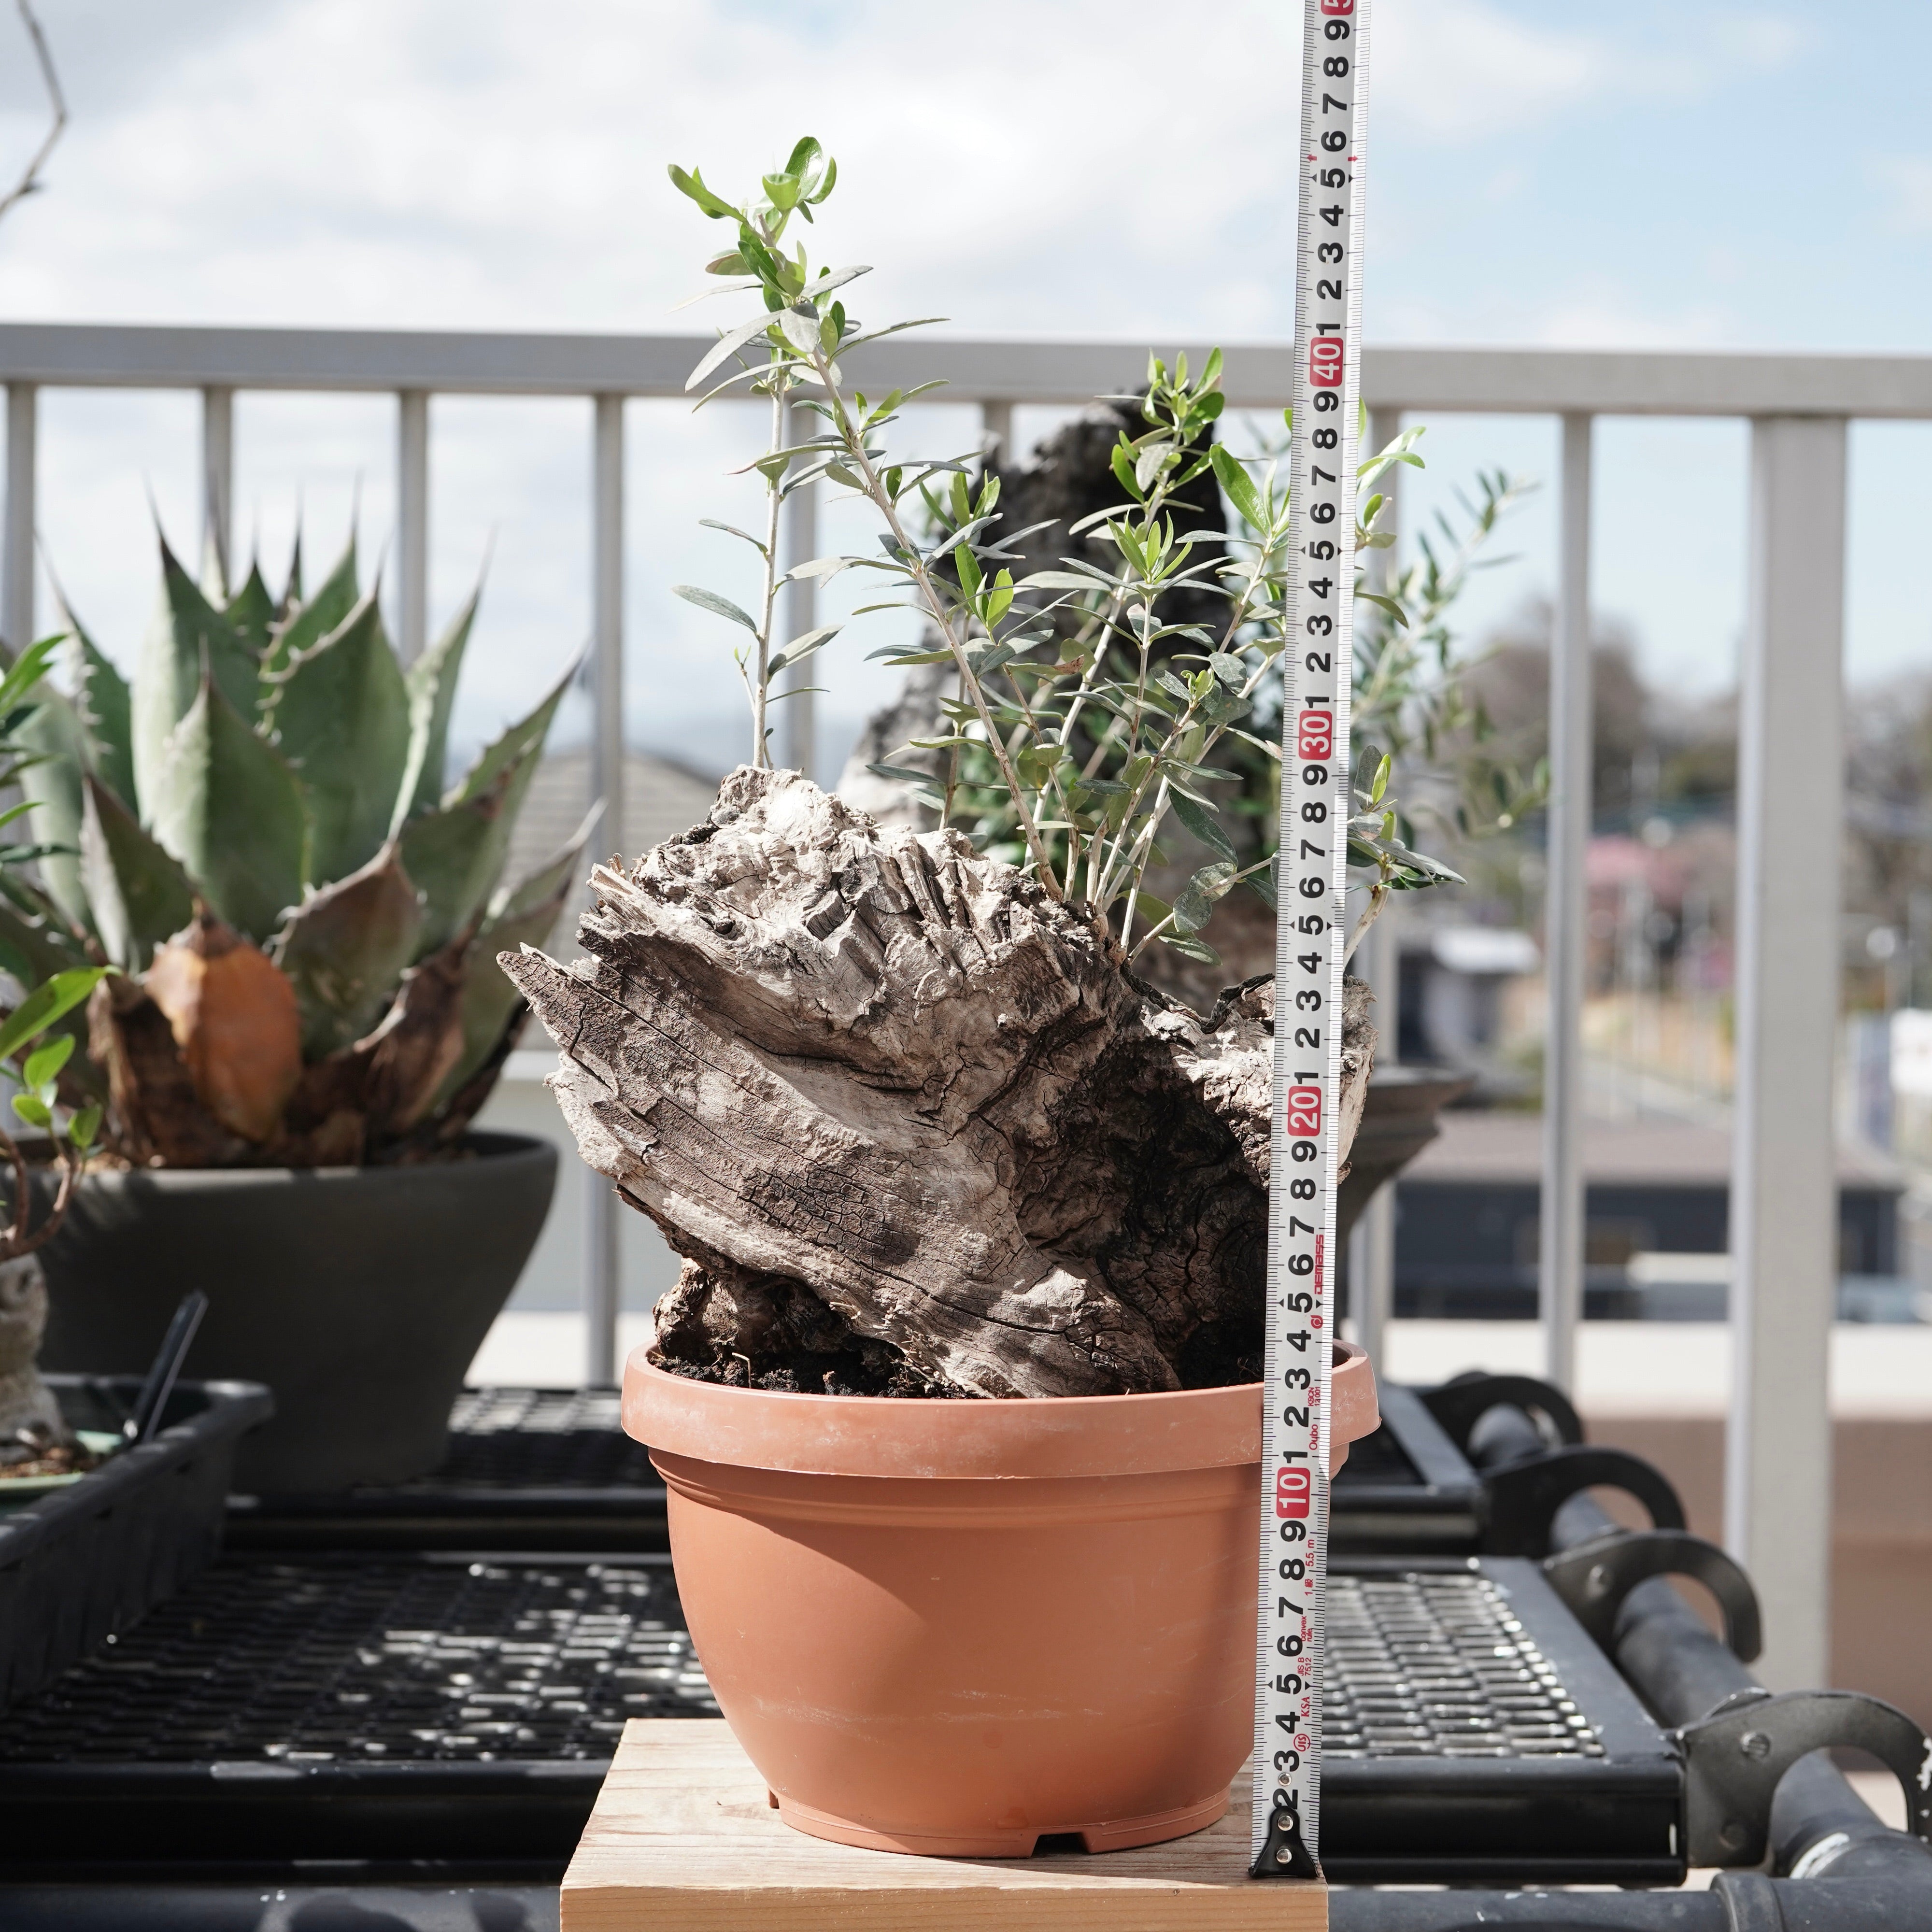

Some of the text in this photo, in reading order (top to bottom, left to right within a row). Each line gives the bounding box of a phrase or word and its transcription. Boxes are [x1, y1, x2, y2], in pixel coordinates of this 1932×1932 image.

[1325, 20, 1350, 40] 9
[1323, 57, 1349, 77] 8
[1322, 94, 1347, 114] 7
[1321, 131, 1346, 152] 6
[1321, 168, 1345, 188] 5
[1320, 205, 1344, 226] 4
[1318, 242, 1343, 263] 3
[1317, 280, 1341, 299] 2
[1316, 324, 1340, 336] 1
[1313, 343, 1340, 379] 40
[1314, 391, 1338, 412] 9
[1312, 428, 1337, 449] 8
[1311, 466, 1336, 485] 7
[1310, 503, 1335, 524] 6
[1309, 540, 1334, 560] 5
[1308, 577, 1333, 598] 4
[1307, 615, 1332, 636] 3
[1306, 652, 1331, 672] 2
[1305, 696, 1329, 708] 1
[1302, 716, 1330, 753] 30
[1303, 765, 1327, 785] 9
[1302, 802, 1326, 823] 8
[1301, 839, 1325, 859] 7
[1299, 877, 1324, 898] 6
[1299, 915, 1323, 935] 5
[1298, 952, 1322, 974] 4
[1296, 990, 1321, 1011] 3
[1295, 1028, 1320, 1048] 2
[1294, 1072, 1318, 1084] 1
[1290, 1092, 1319, 1130] 20
[1292, 1141, 1317, 1162] 9
[1291, 1179, 1316, 1200] 8
[1290, 1216, 1314, 1236] 7
[1288, 1254, 1313, 1275] 6
[1288, 1293, 1312, 1313] 5
[1287, 1330, 1311, 1351] 4
[1285, 1368, 1310, 1390] 3
[1284, 1406, 1309, 1427] 2
[1309, 1424, 1318, 1450] Oubo
[1283, 1451, 1307, 1463] 1
[1279, 1473, 1307, 1508] 10
[1280, 1520, 1306, 1542] 9
[1307, 1539, 1314, 1548] m
[1279, 1559, 1305, 1580] 8
[1305, 1552, 1314, 1567] 5.5
[1279, 1597, 1303, 1618] 7
[1277, 1635, 1303, 1657] 6
[1277, 1674, 1301, 1694] 5
[1301, 1697, 1310, 1718] KSA
[1276, 1712, 1300, 1734] 4
[1274, 1750, 1299, 1772] 3
[1273, 1788, 1298, 1809] 2
